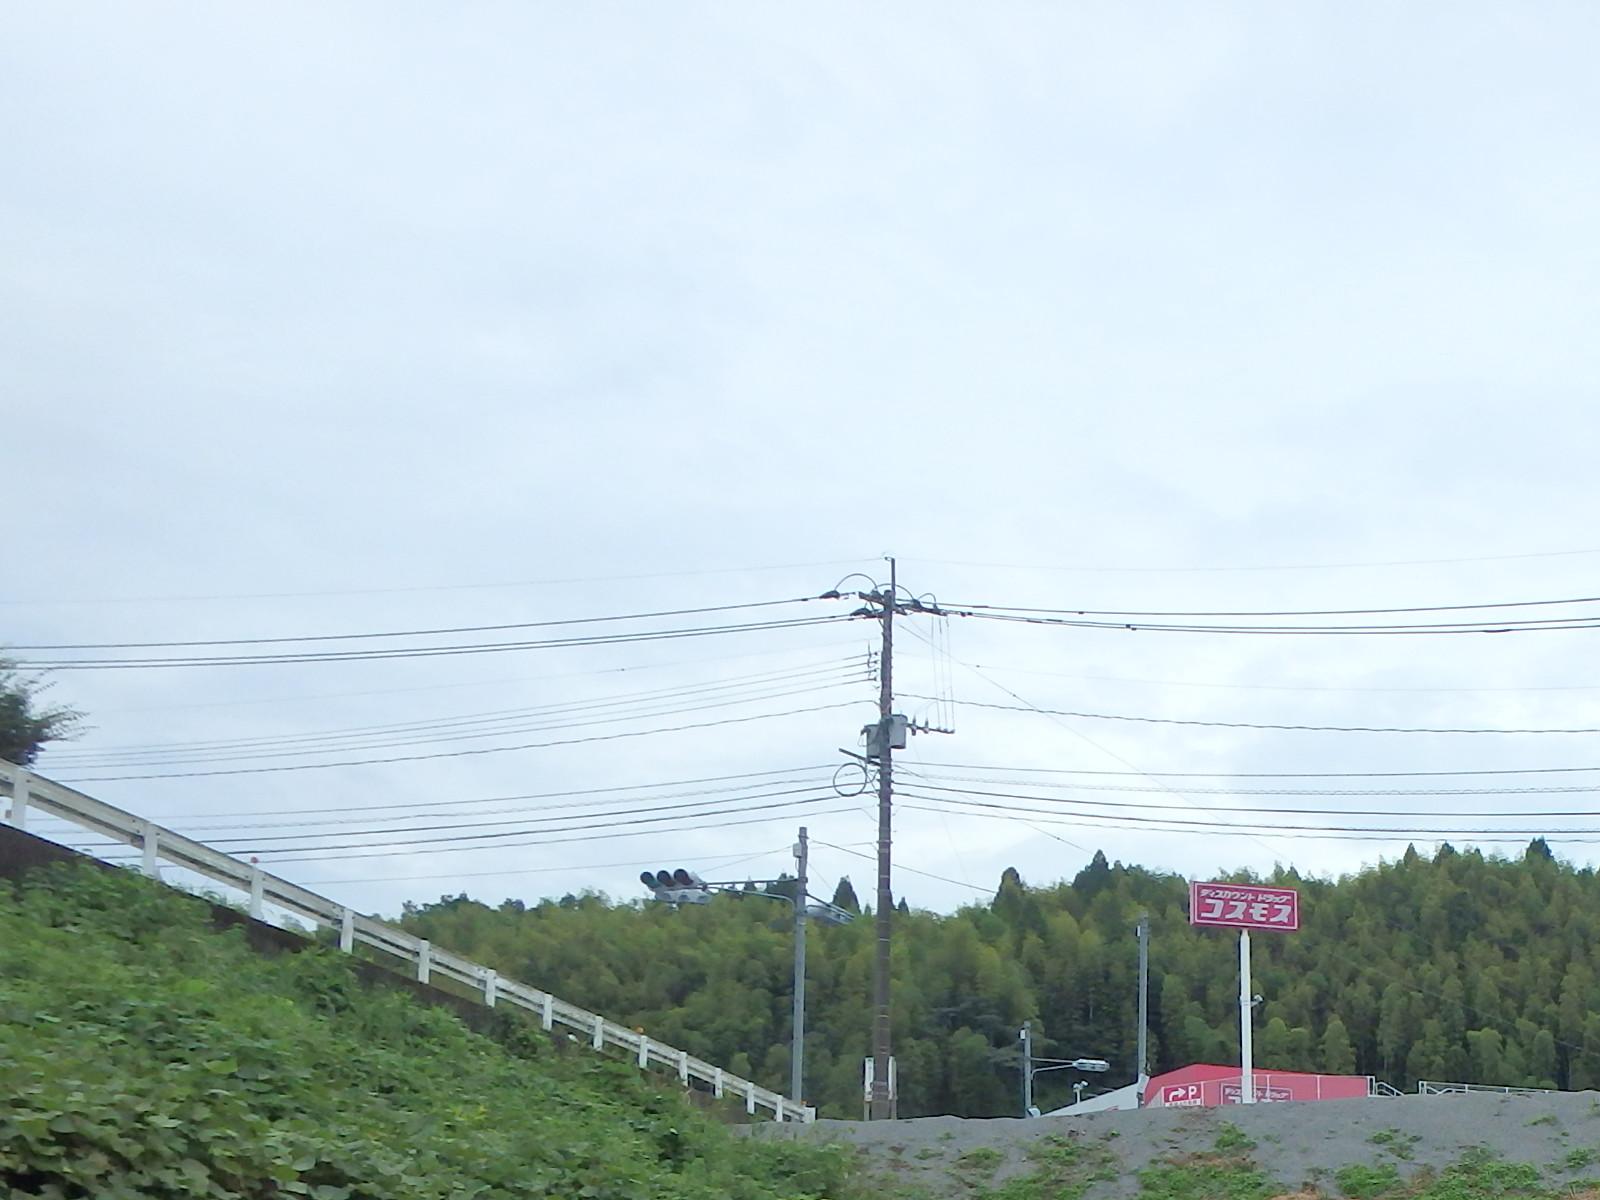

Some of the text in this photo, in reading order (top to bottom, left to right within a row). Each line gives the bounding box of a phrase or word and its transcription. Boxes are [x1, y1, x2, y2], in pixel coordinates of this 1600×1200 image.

[1200, 898, 1292, 923] コスモス
[1188, 1085, 1197, 1099] P
